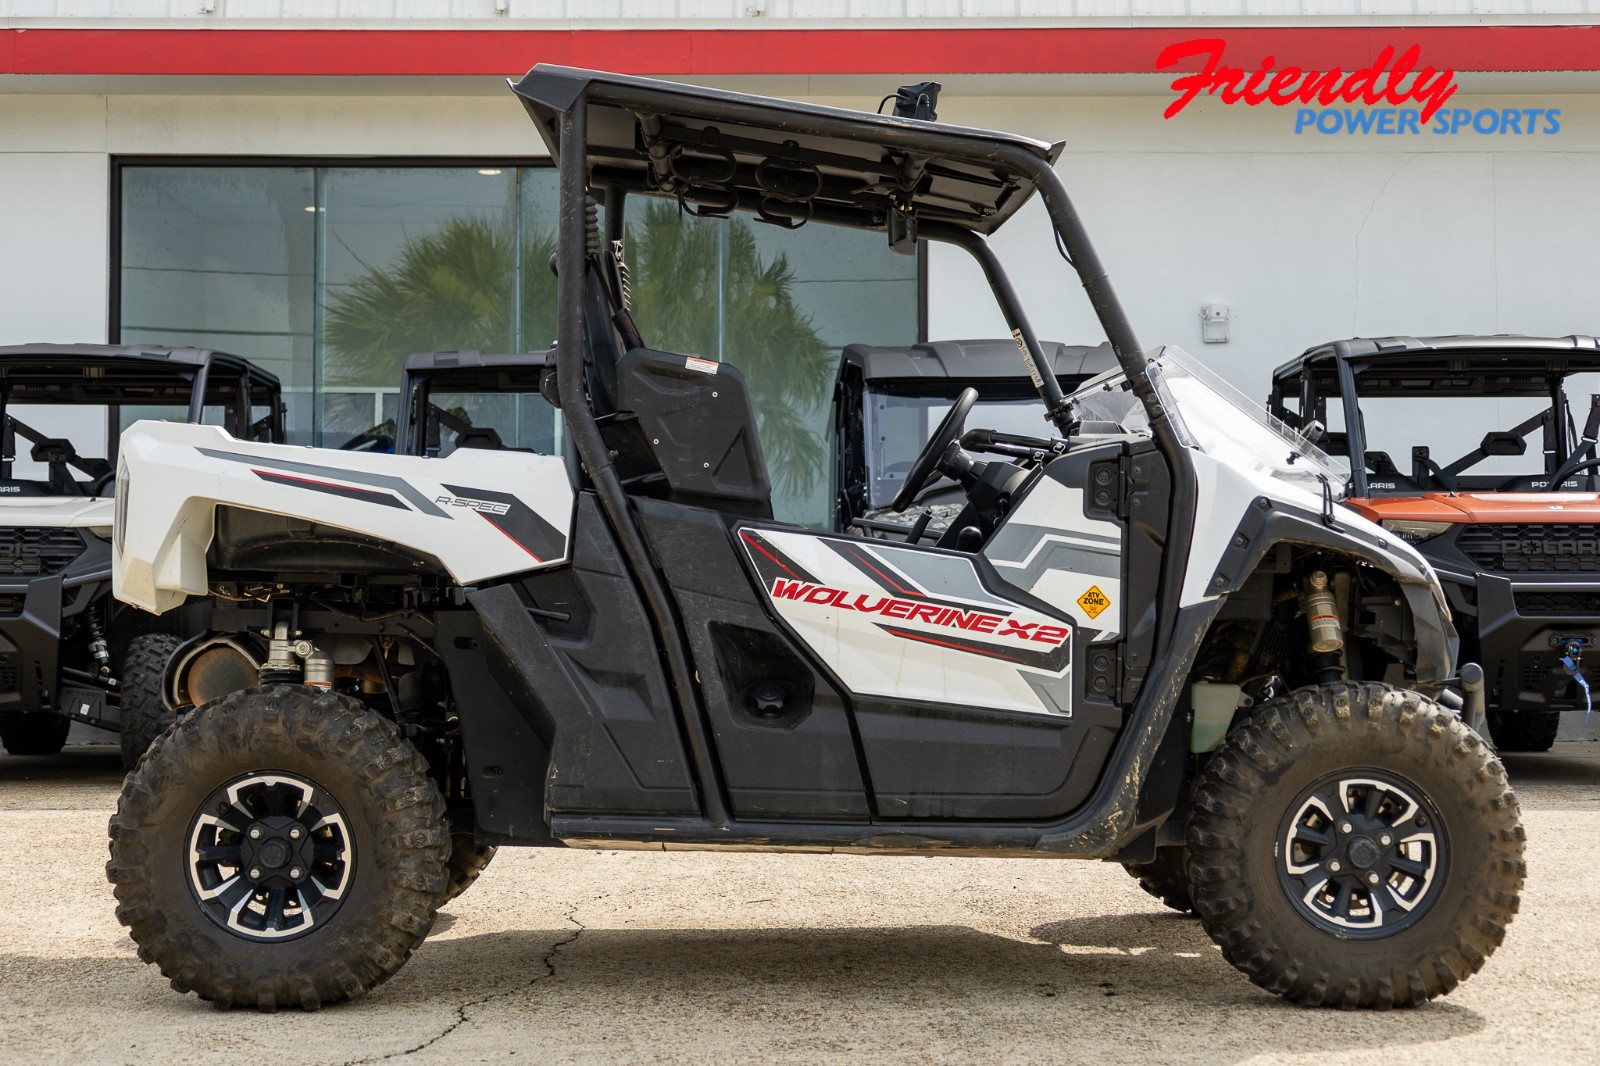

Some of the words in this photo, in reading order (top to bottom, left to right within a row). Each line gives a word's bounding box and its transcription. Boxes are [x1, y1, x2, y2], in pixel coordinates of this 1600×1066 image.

[1531, 480, 1578, 488] PORIS
[1087, 591, 1100, 599] ATV
[1083, 597, 1105, 606] ZONE
[772, 579, 1003, 634] WOLVERINE
[998, 619, 1069, 645] X2
